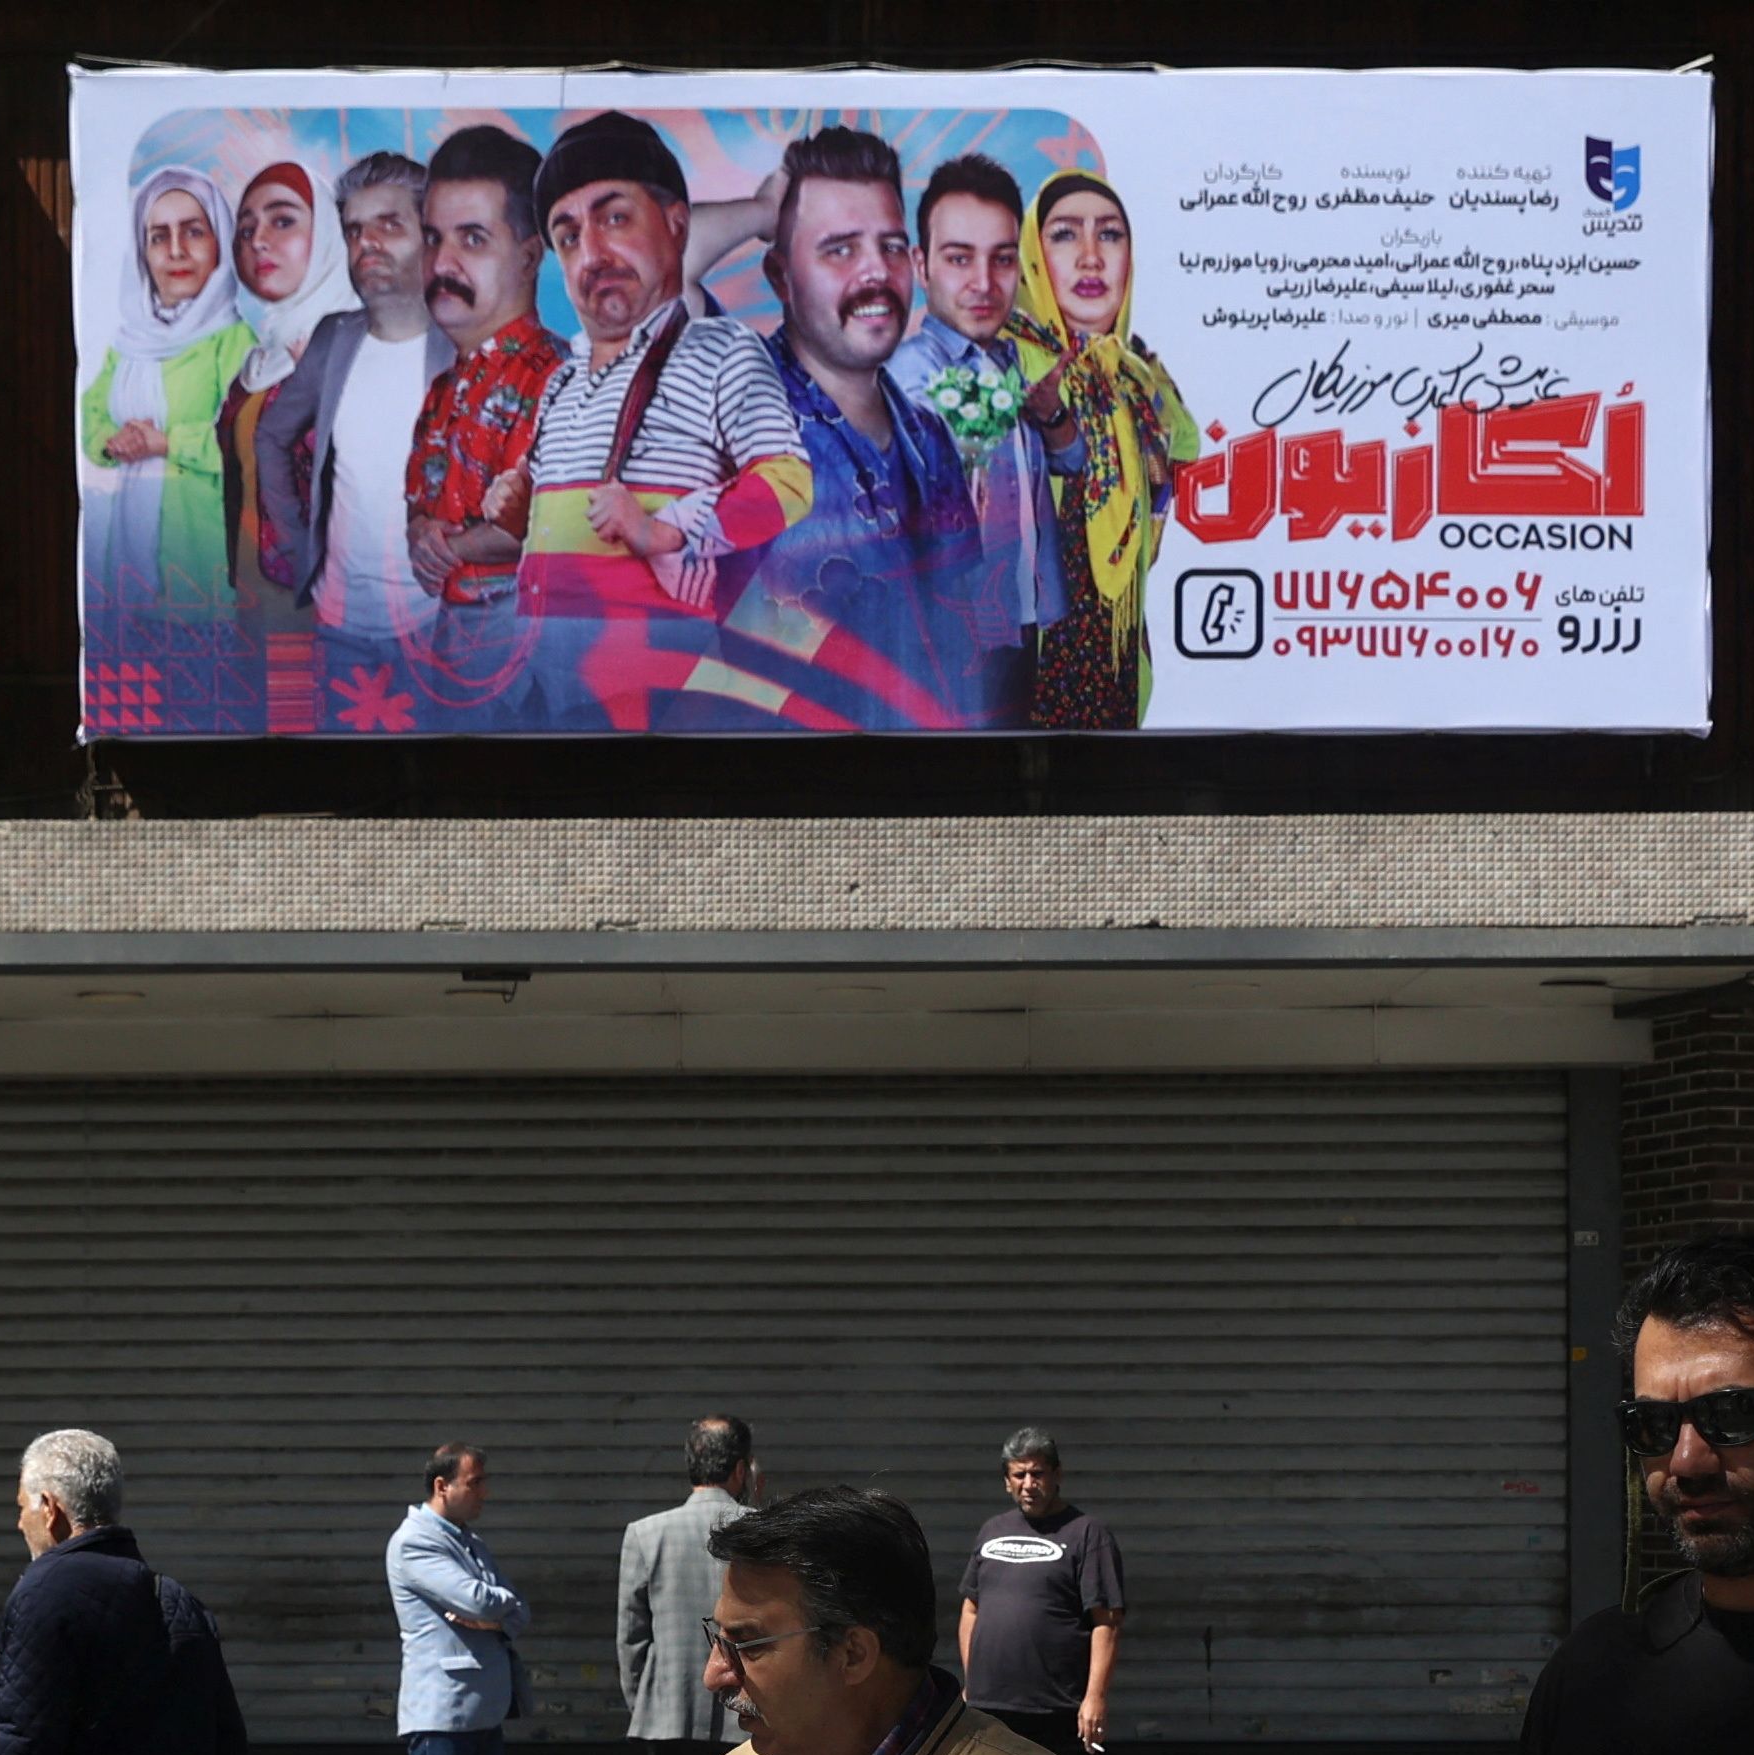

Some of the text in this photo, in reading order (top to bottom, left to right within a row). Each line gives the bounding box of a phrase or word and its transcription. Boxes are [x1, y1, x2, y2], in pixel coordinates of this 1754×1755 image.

[1203, 162, 1284, 184] کارگردان
[1340, 164, 1412, 184] نویسنده
[1456, 164, 1552, 185] تهیه کننده
[1179, 182, 1307, 213] روح الله عمرانی
[1315, 186, 1436, 212] حنیف مظفری
[1449, 188, 1560, 214] رضا پسندیان
[1379, 228, 1443, 249] بازیگران
[1555, 253, 1587, 275] ایزد
[1588, 254, 1642, 275] حسین
[1265, 278, 1312, 299] زرینی
[1313, 277, 1368, 300] علیرضا
[1427, 276, 1454, 299] لیلا
[1516, 283, 1556, 300] سحر
[1202, 306, 1272, 331] پرینوش
[1272, 307, 1326, 330] علیرضا
[1427, 311, 1470, 329] میری
[1471, 308, 1543, 329] مصطفی
[1438, 521, 1634, 551] OCCASION
[1554, 583, 1645, 607] تلفن های
[1556, 608, 1643, 654] رزرو
